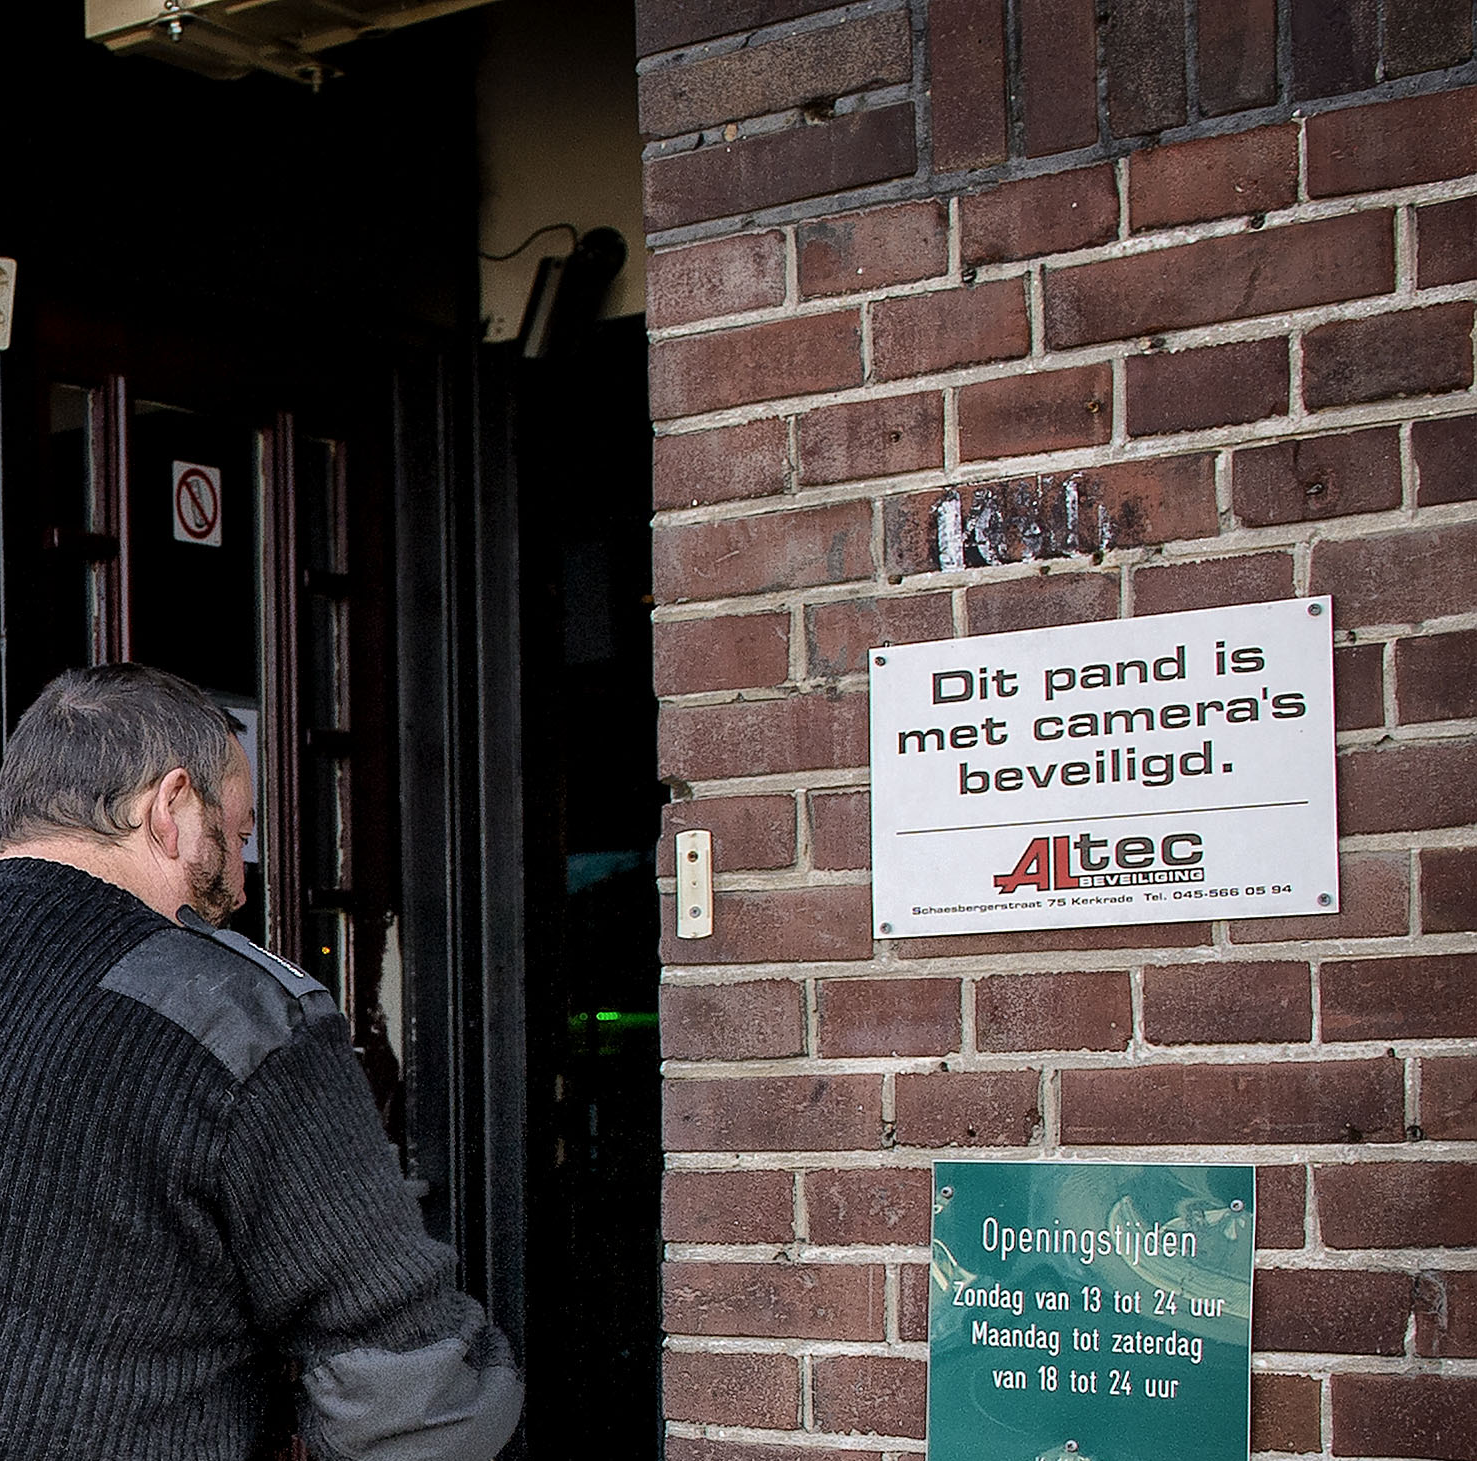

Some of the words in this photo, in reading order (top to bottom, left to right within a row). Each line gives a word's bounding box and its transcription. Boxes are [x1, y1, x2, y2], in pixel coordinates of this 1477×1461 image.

[932, 666, 1019, 705] Dit
[1044, 645, 1186, 701] pand
[1215, 641, 1266, 676] is
[898, 715, 1008, 755] met
[1033, 688, 1307, 742] camera's
[959, 740, 1234, 795] beveiligd.
[912, 900, 1042, 916] Schaesbergerstraat
[1047, 898, 1067, 908] 75
[1071, 893, 1133, 906] Kerkrade
[1144, 893, 1167, 902] Tel.
[1245, 885, 1266, 895] 05
[1271, 884, 1293, 895] 94
[1079, 869, 1204, 888] BEVEILIGING
[981, 1216, 1198, 1265] Openingstijden
[952, 1281, 1025, 1314] Zondag
[1035, 1289, 1070, 1312] van
[1080, 1287, 1102, 1312] 13
[1113, 1290, 1142, 1314] tot
[1153, 1290, 1178, 1315] 24
[1190, 1297, 1225, 1318] uur
[971, 1321, 1061, 1356] Maandag
[1072, 1328, 1100, 1353] tot
[1111, 1330, 1204, 1364] zaterdag
[992, 1369, 1027, 1390] van
[1037, 1366, 1059, 1391] 18
[1069, 1369, 1098, 1394] tot
[1109, 1370, 1133, 1396] 24
[1145, 1377, 1180, 1399] uur
